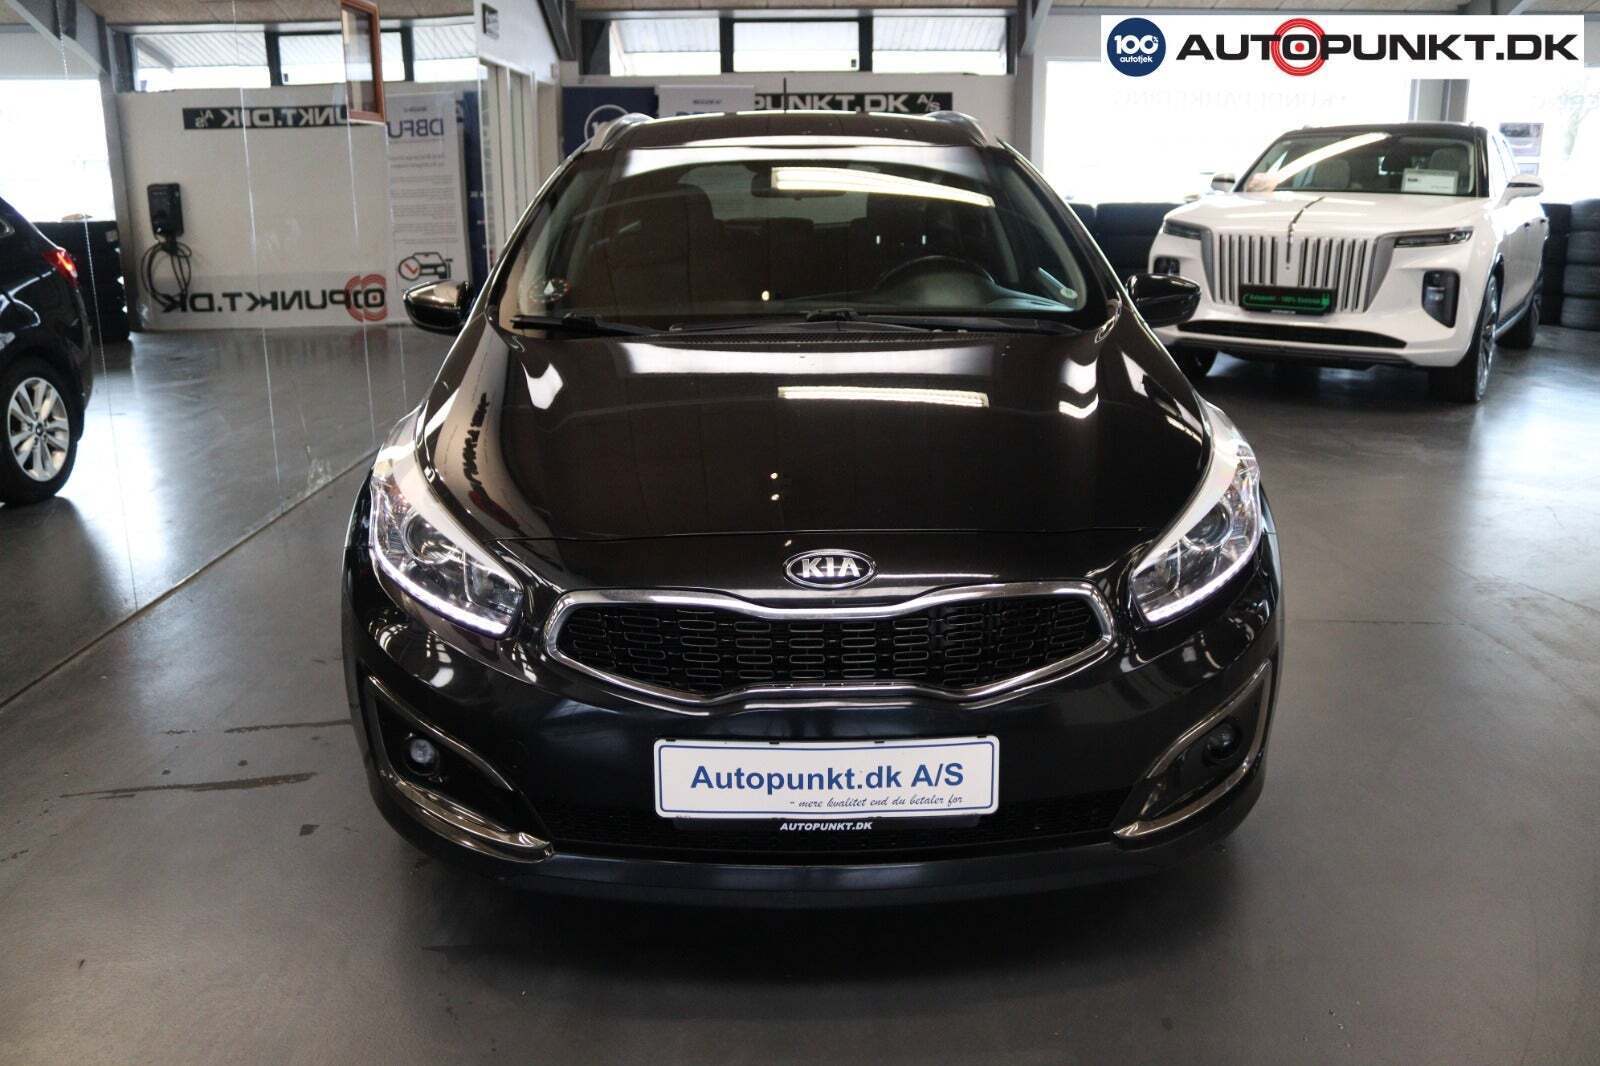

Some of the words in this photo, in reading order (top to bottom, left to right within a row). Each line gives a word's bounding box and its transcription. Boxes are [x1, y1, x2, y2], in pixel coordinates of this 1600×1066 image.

[801, 557, 861, 578] KIA
[690, 765, 901, 795] Autopunkt.dk
[911, 762, 964, 788] A/S
[827, 795, 867, 808] kvalitet
[870, 797, 889, 807] end
[892, 796, 907, 807] du
[909, 795, 945, 806] betaler
[779, 822, 873, 832] AUTOPUNKT.DK
